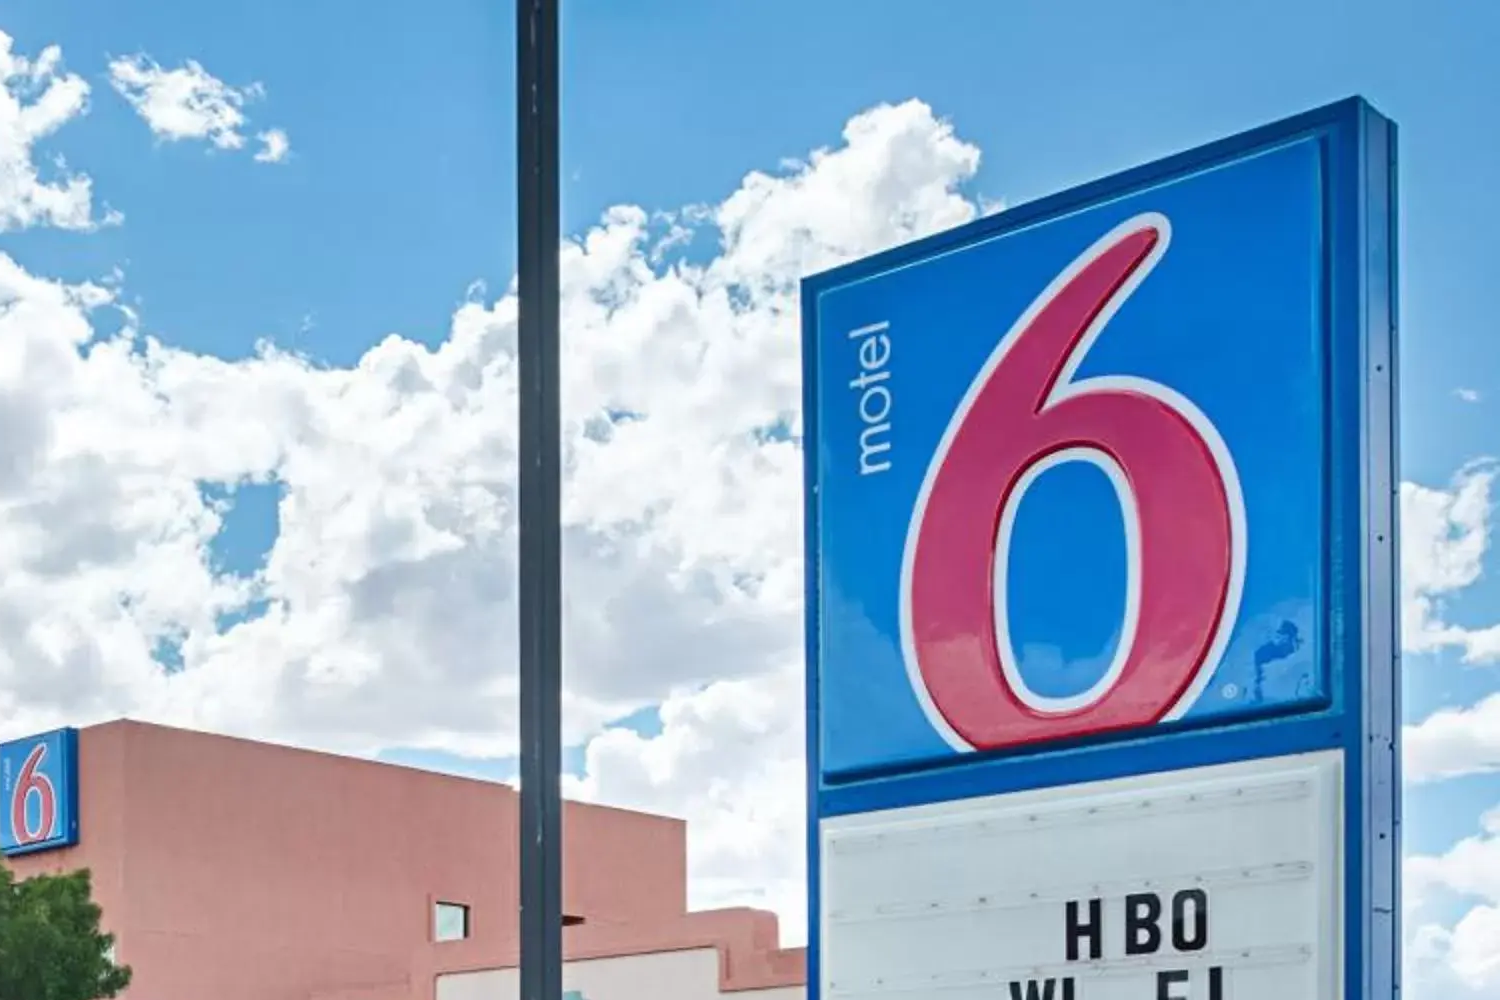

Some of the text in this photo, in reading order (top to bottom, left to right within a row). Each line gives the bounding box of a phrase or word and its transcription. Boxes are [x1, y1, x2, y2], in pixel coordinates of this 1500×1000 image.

[848, 320, 891, 475] motel
[899, 211, 1248, 752] 6
[11, 742, 57, 845] 6
